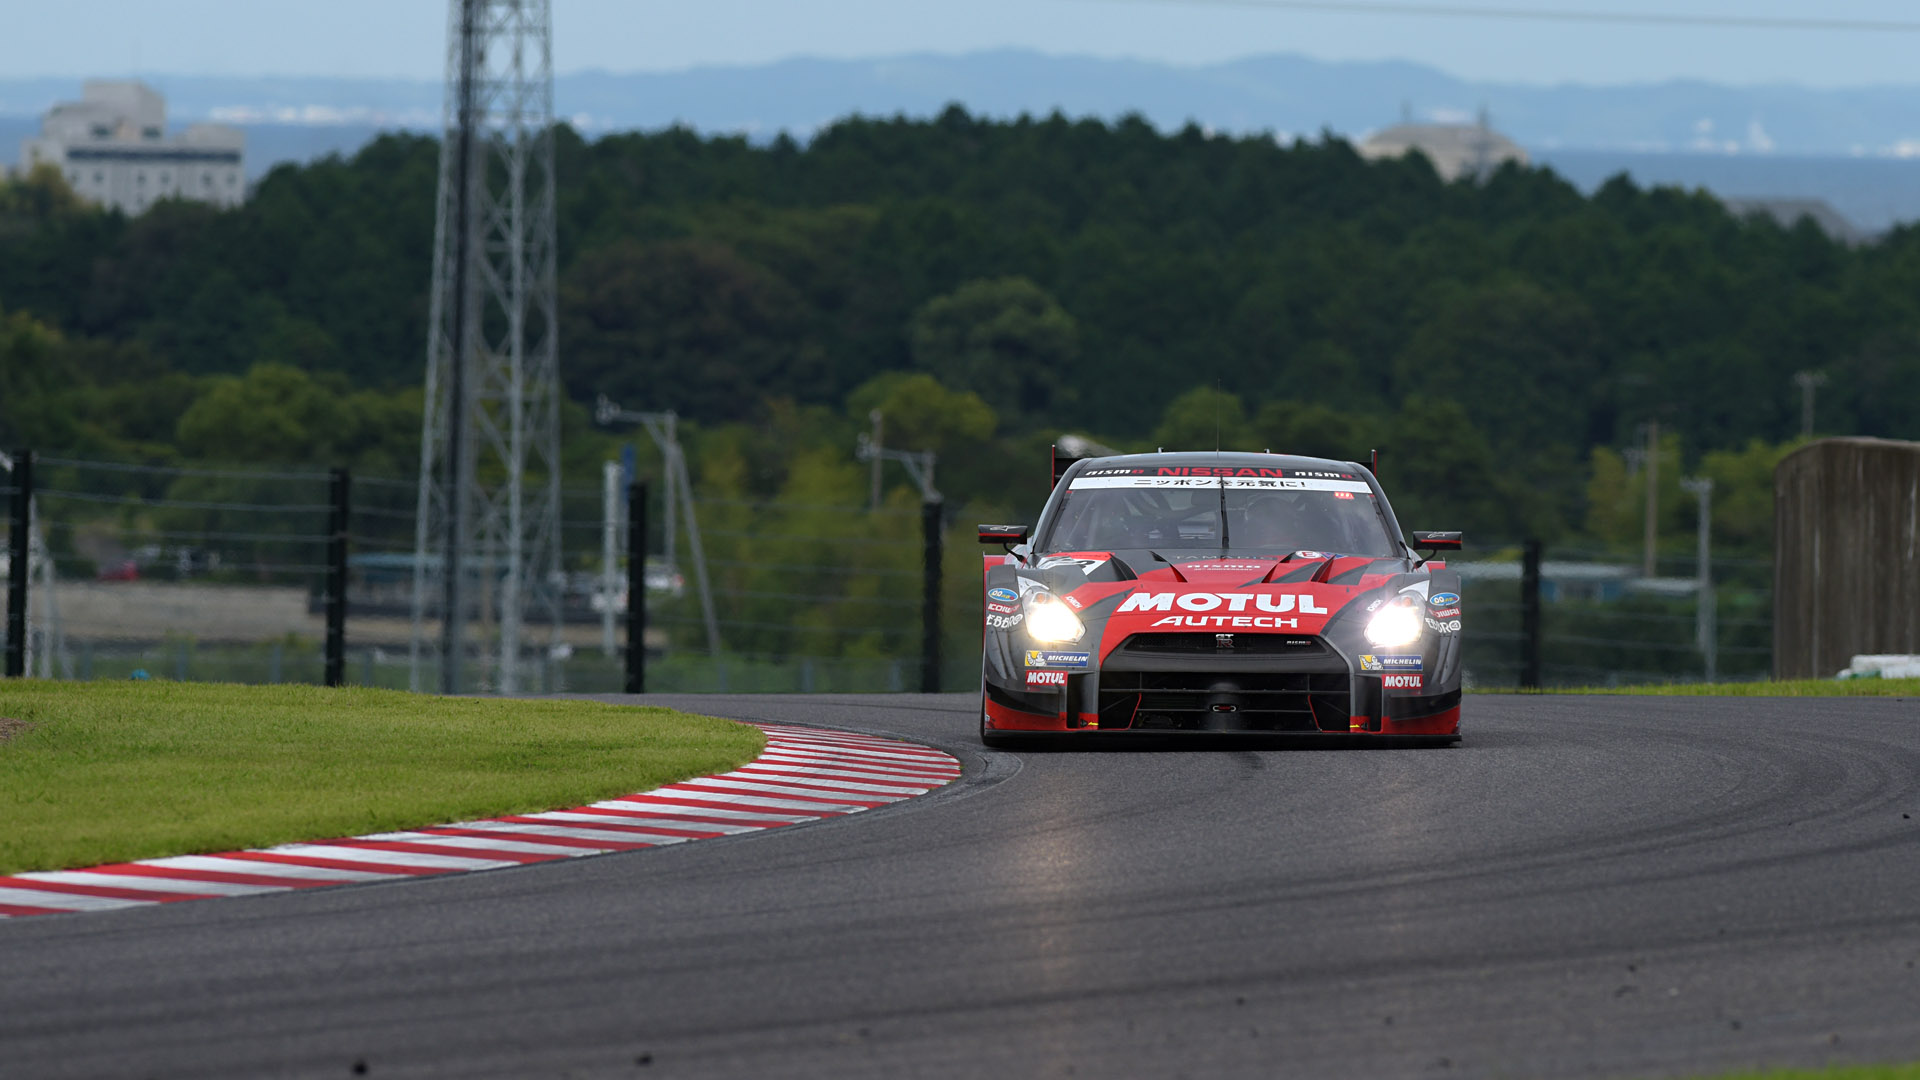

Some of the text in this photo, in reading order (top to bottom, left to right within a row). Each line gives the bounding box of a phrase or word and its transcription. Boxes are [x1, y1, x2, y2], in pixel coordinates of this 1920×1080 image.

[1157, 467, 1283, 478] NISSAN
[1117, 592, 1328, 615] MOTUL
[1151, 615, 1298, 628] AUTECH
[1027, 672, 1065, 684] MOTUL
[1384, 676, 1422, 687] MOTUL
